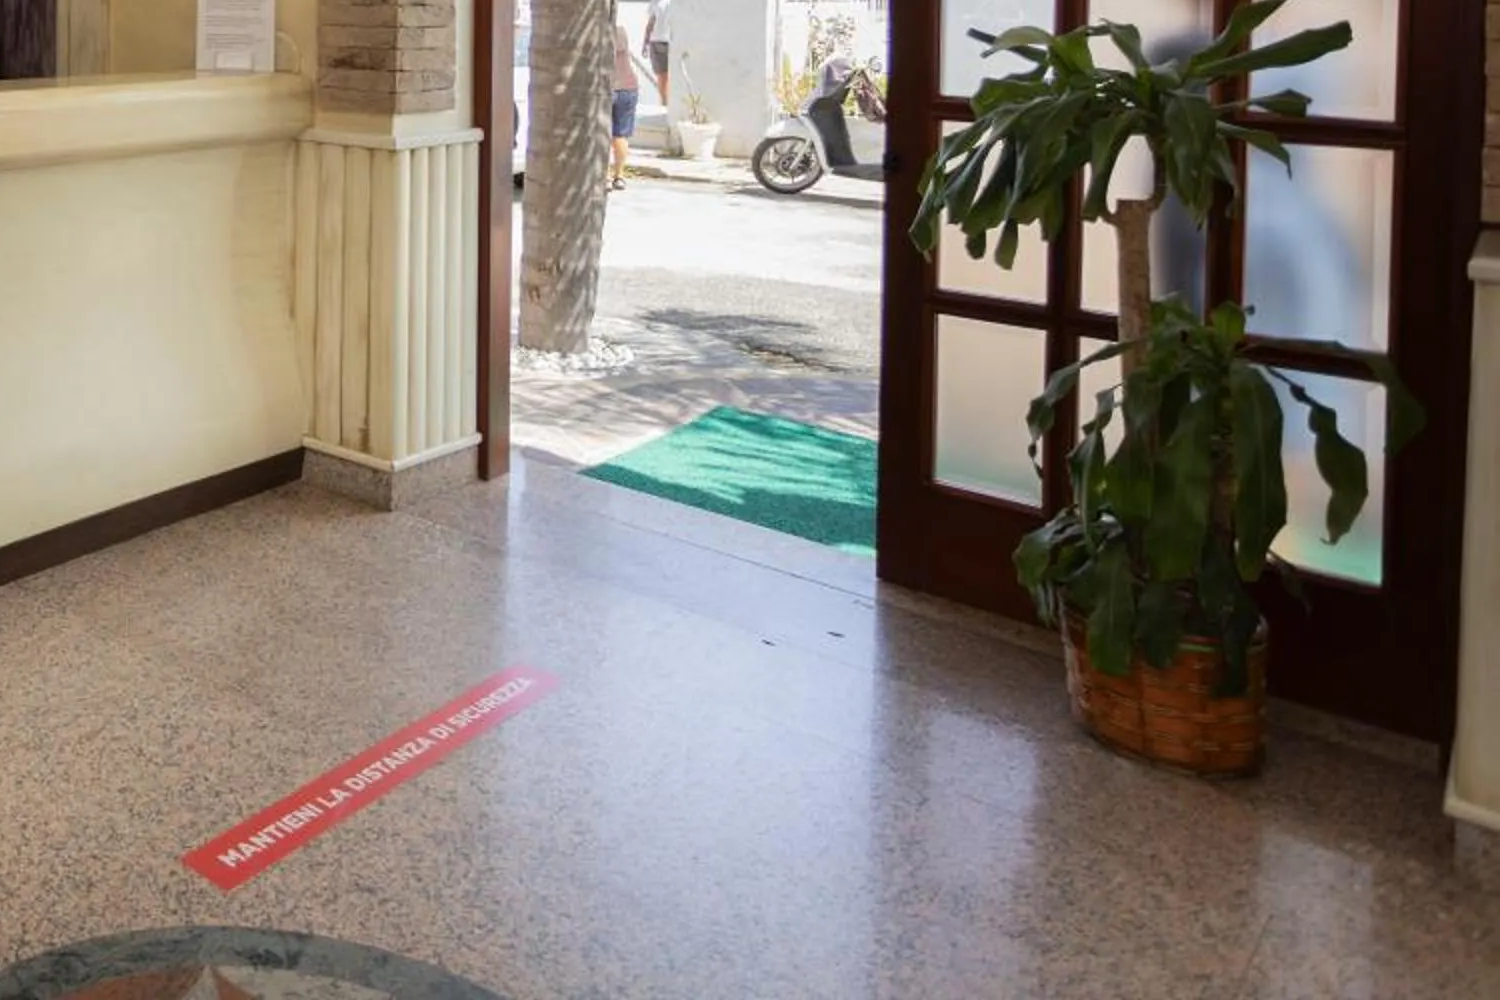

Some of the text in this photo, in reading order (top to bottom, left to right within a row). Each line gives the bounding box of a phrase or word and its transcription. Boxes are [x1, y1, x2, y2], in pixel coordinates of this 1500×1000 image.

[217, 803, 324, 868] MANTIENI
[317, 787, 352, 810] LA
[344, 736, 436, 791] DISTANZA
[428, 720, 455, 740] DI
